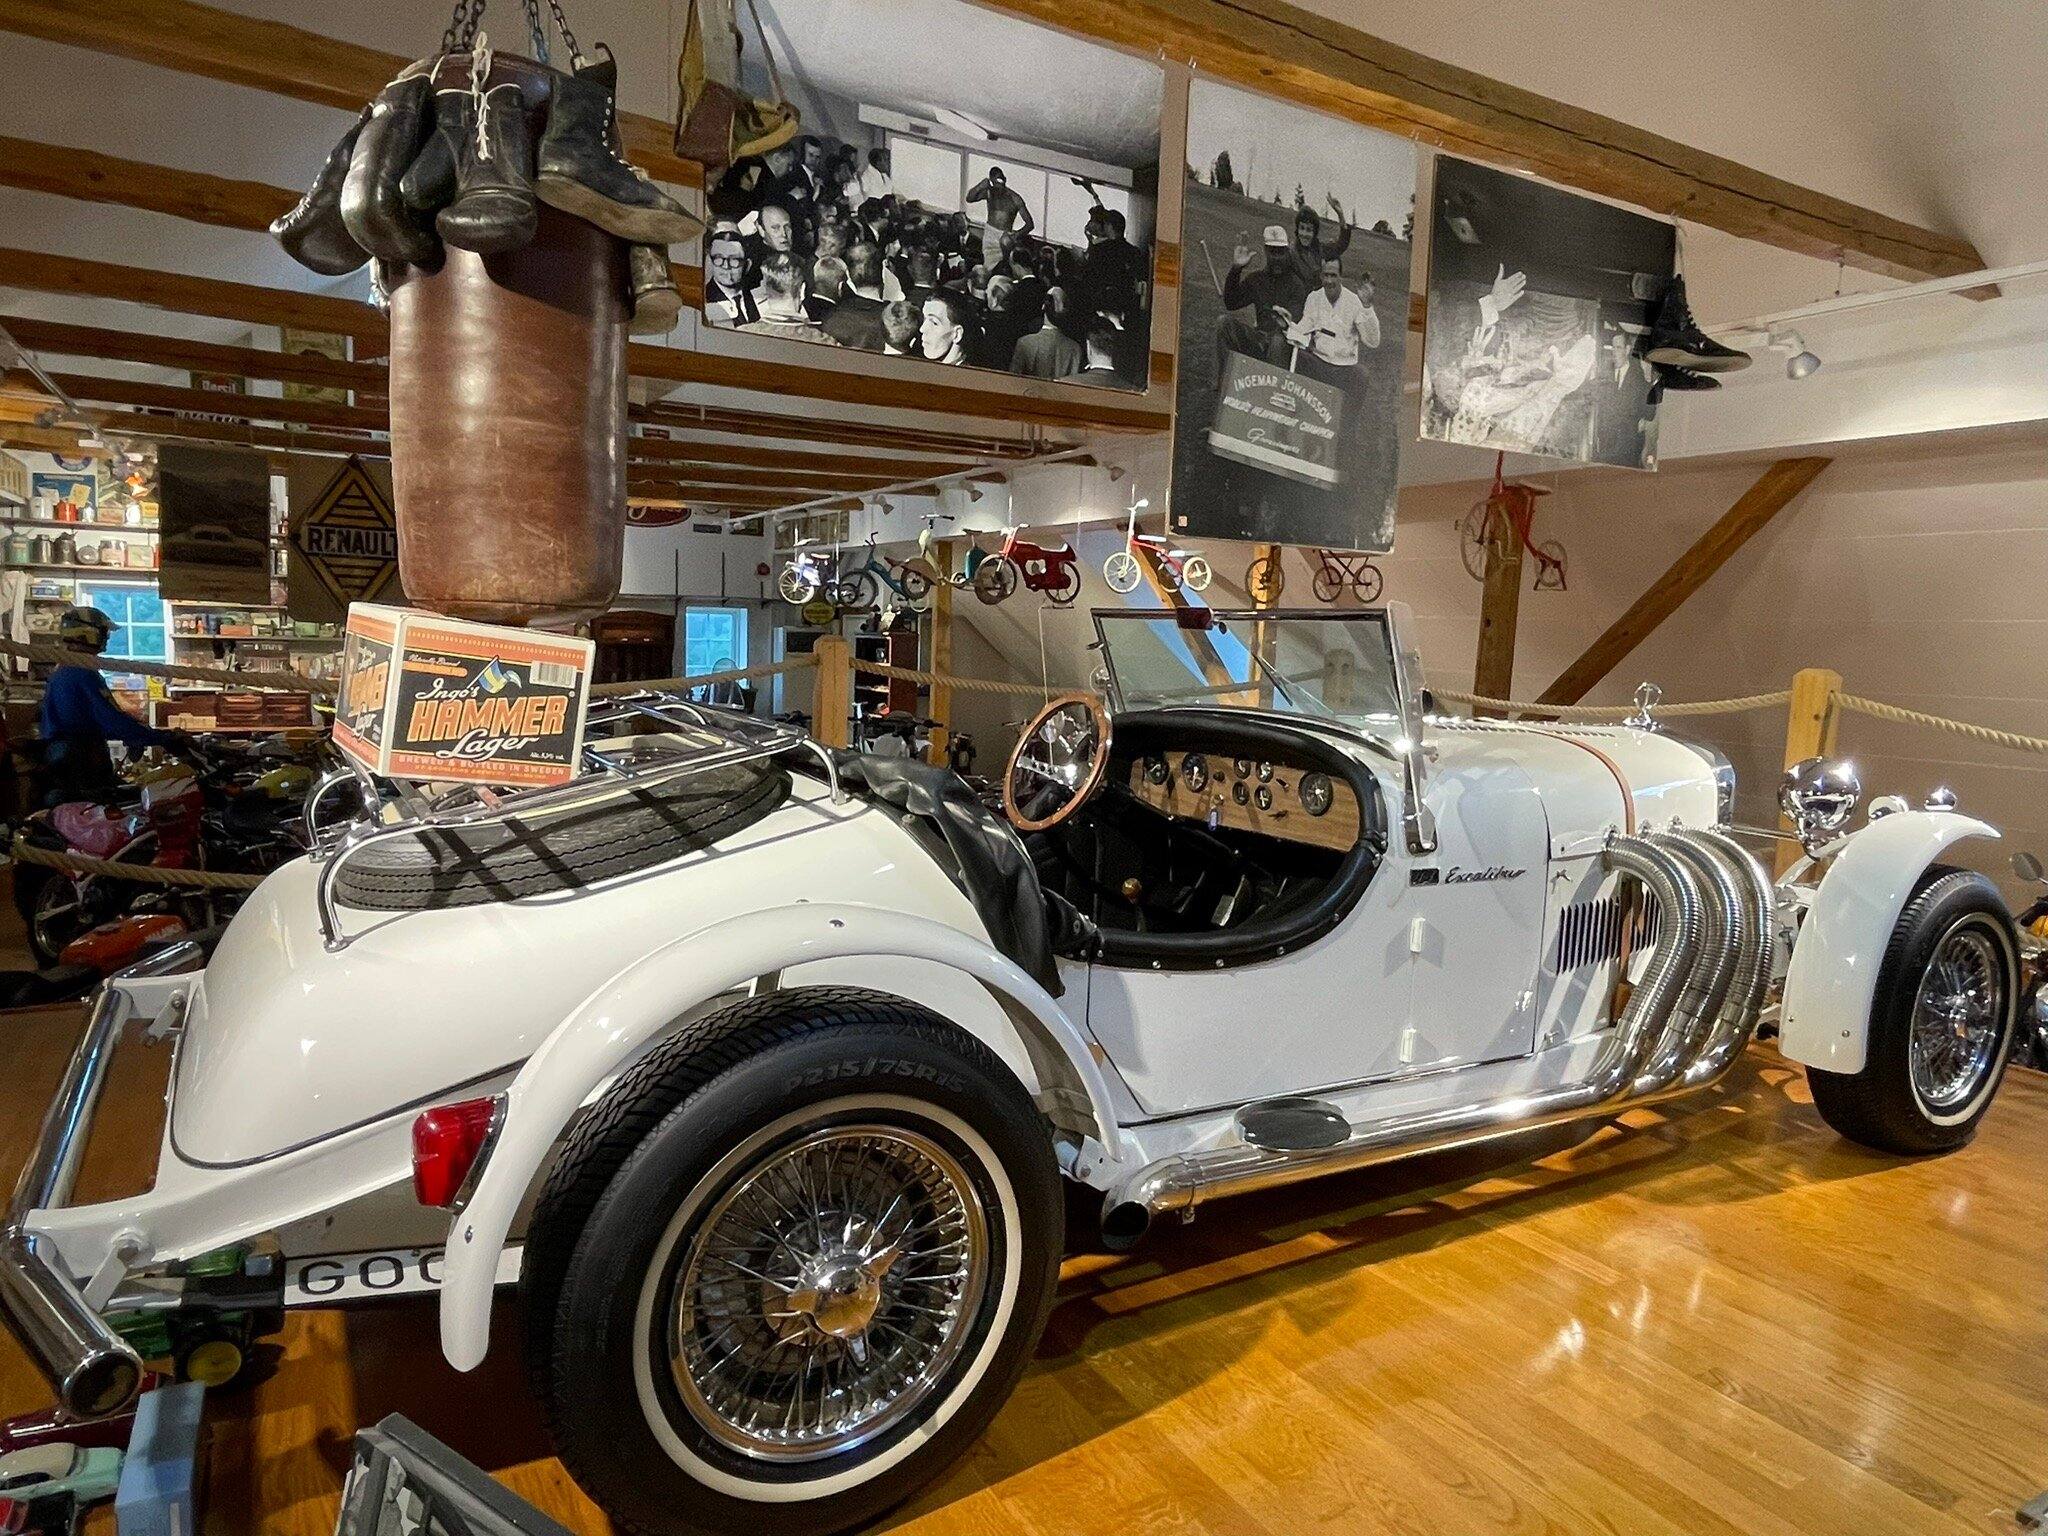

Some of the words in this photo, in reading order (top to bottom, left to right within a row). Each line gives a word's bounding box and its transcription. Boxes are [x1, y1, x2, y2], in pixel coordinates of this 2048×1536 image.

[1233, 374, 1278, 391] INGEMAR
[1281, 379, 1332, 424] JOHANSSON
[415, 678, 480, 703] Ingo's
[406, 695, 569, 743] HAMMER
[436, 728, 540, 761] Lager
[398, 755, 443, 767] BREWED
[460, 760, 505, 771] BOTTLED
[523, 765, 565, 775] SWEDEN
[1444, 866, 1527, 884] Excalibur
